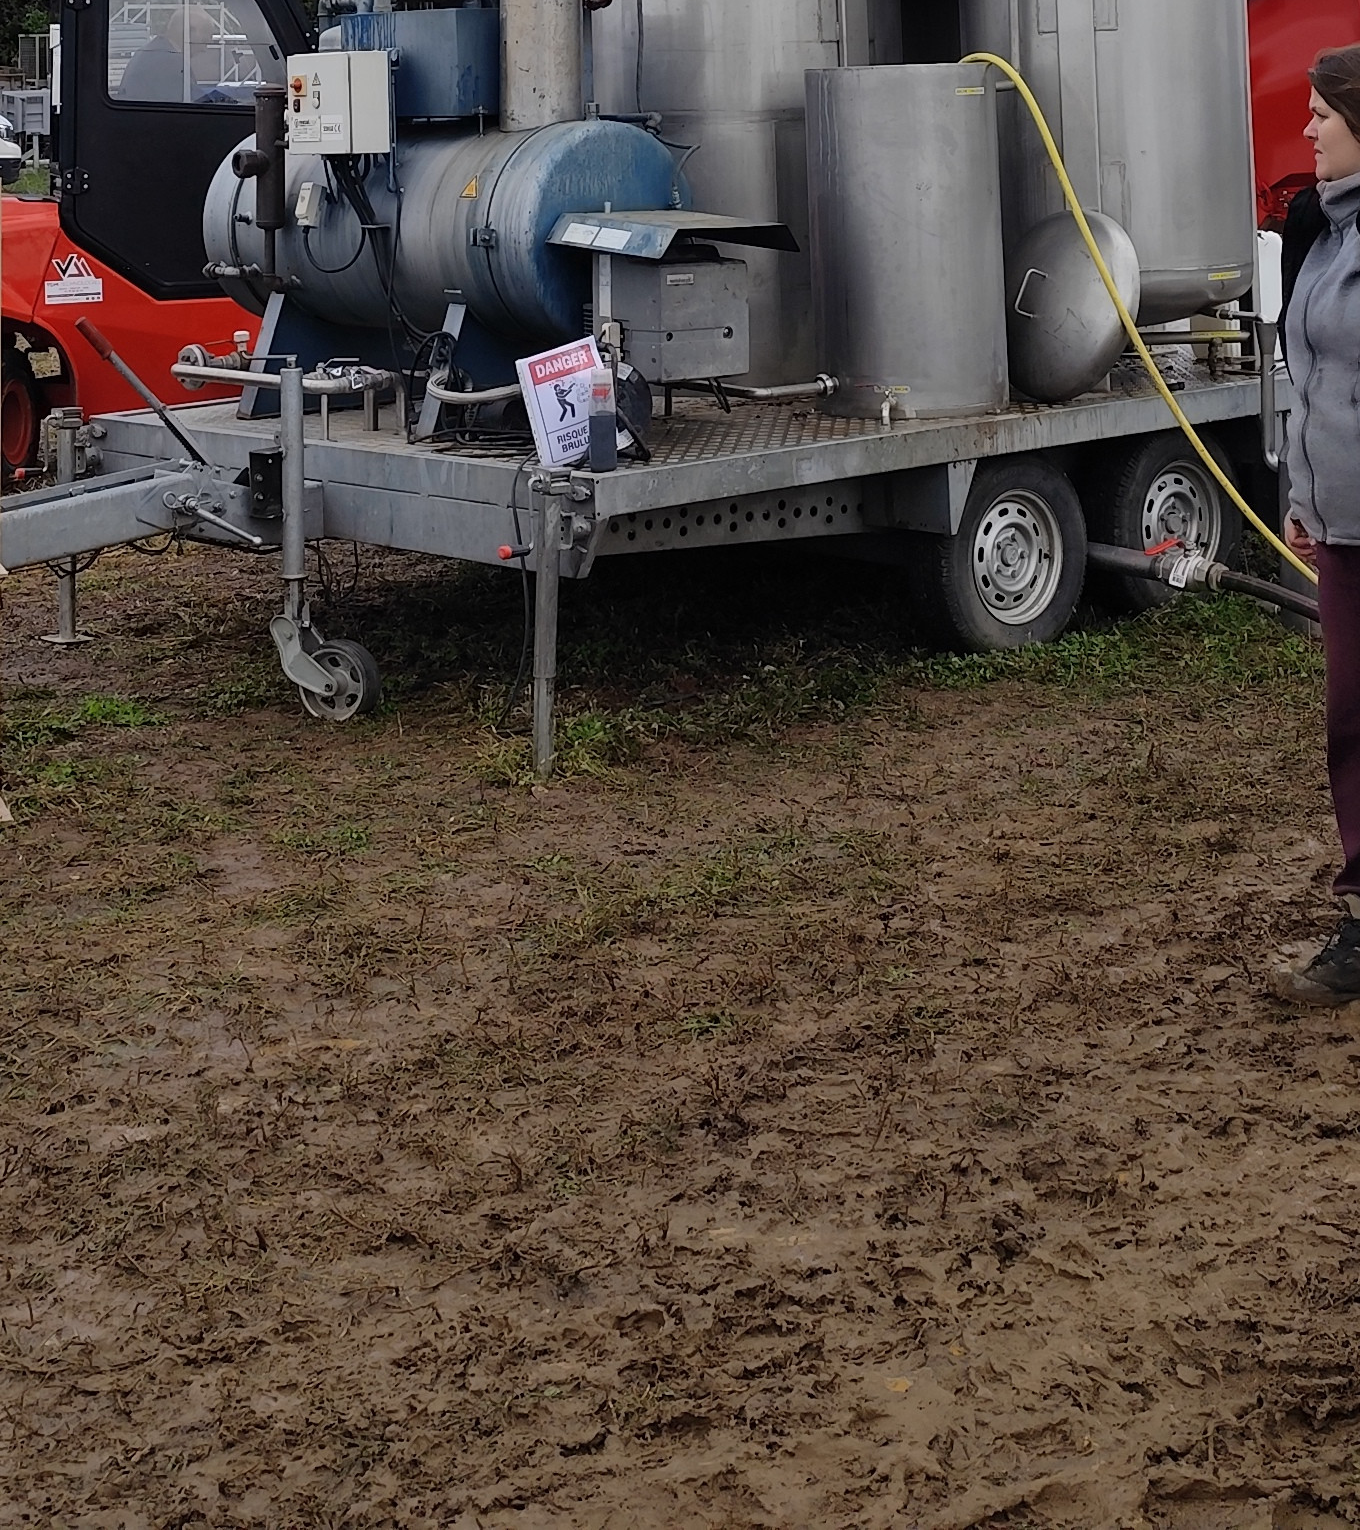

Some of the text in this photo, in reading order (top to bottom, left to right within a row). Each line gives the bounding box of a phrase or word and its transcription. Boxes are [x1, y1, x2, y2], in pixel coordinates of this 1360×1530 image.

[534, 350, 589, 379] DANGER
[556, 425, 589, 444] RISQUE
[561, 436, 590, 453] BRULU
